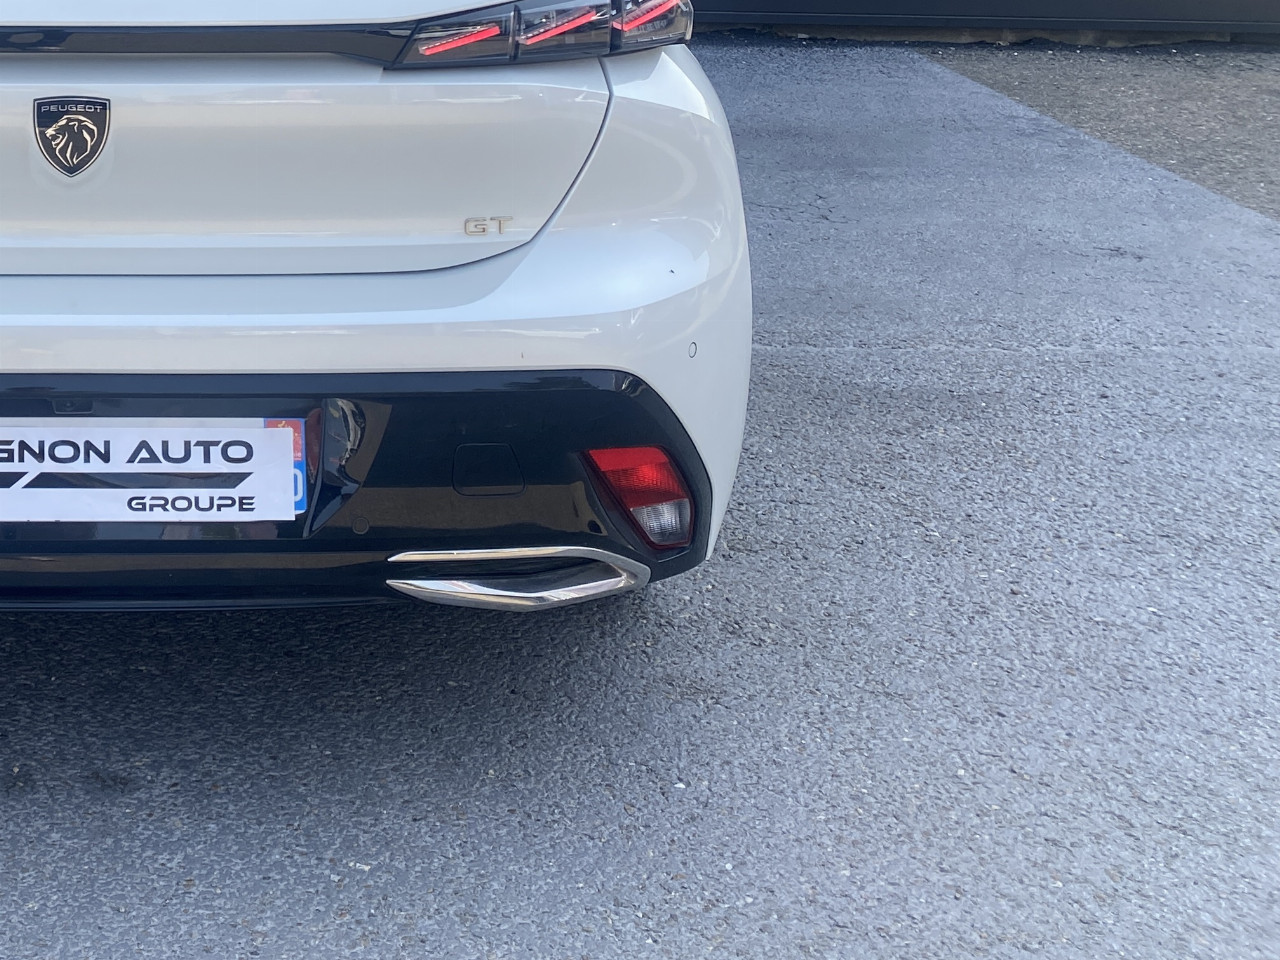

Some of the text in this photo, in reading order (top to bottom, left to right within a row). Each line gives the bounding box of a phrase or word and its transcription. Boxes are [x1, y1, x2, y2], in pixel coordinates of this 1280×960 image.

[41, 105, 103, 113] PEUGEOT
[464, 216, 514, 236] GT
[126, 440, 254, 464] AUTO
[127, 495, 256, 512] GROUPE
